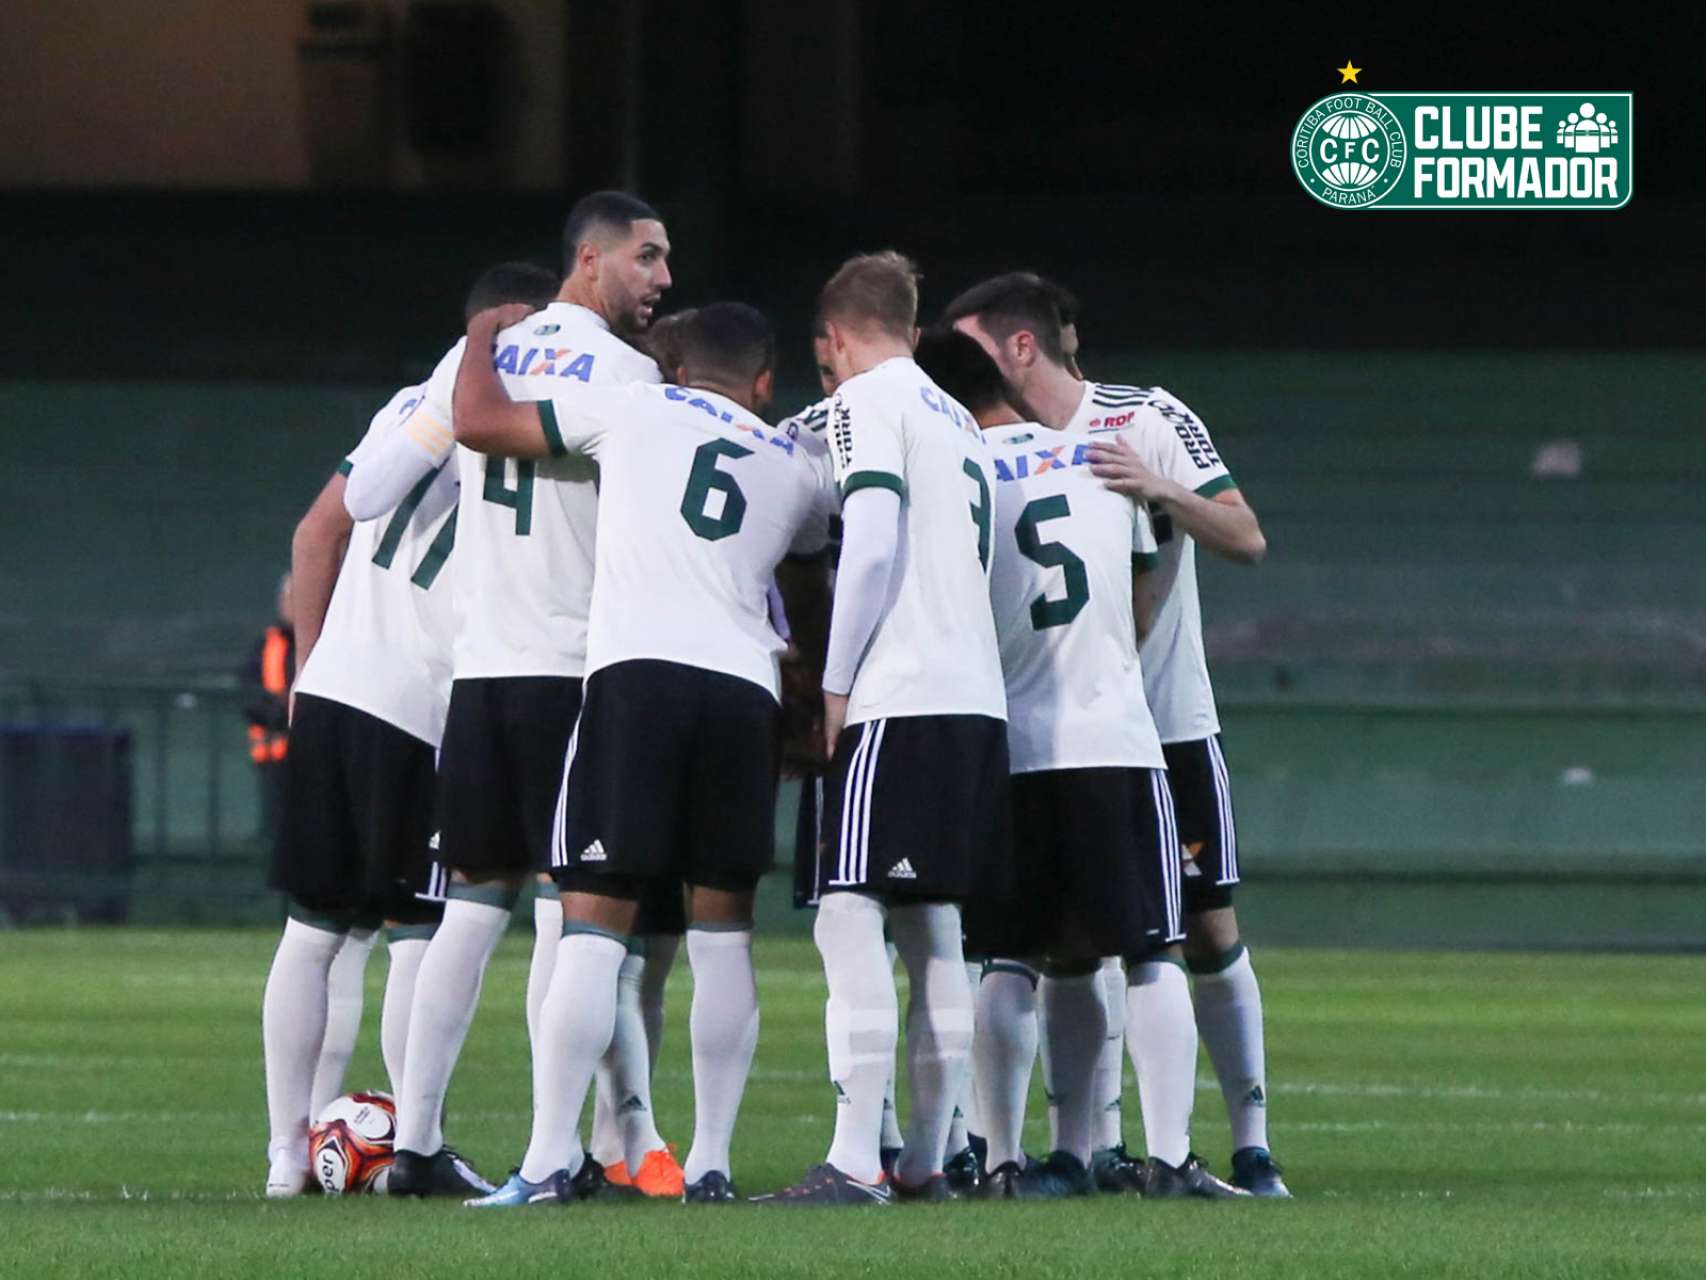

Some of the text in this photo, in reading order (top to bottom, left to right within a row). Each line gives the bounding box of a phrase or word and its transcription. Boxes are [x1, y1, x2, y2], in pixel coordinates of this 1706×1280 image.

[493, 344, 594, 382] AIXA
[680, 437, 755, 541] 6
[994, 445, 1089, 481] AIXA
[483, 457, 535, 536] 4
[1014, 494, 1090, 630] 5
[322, 1154, 341, 1193] per
